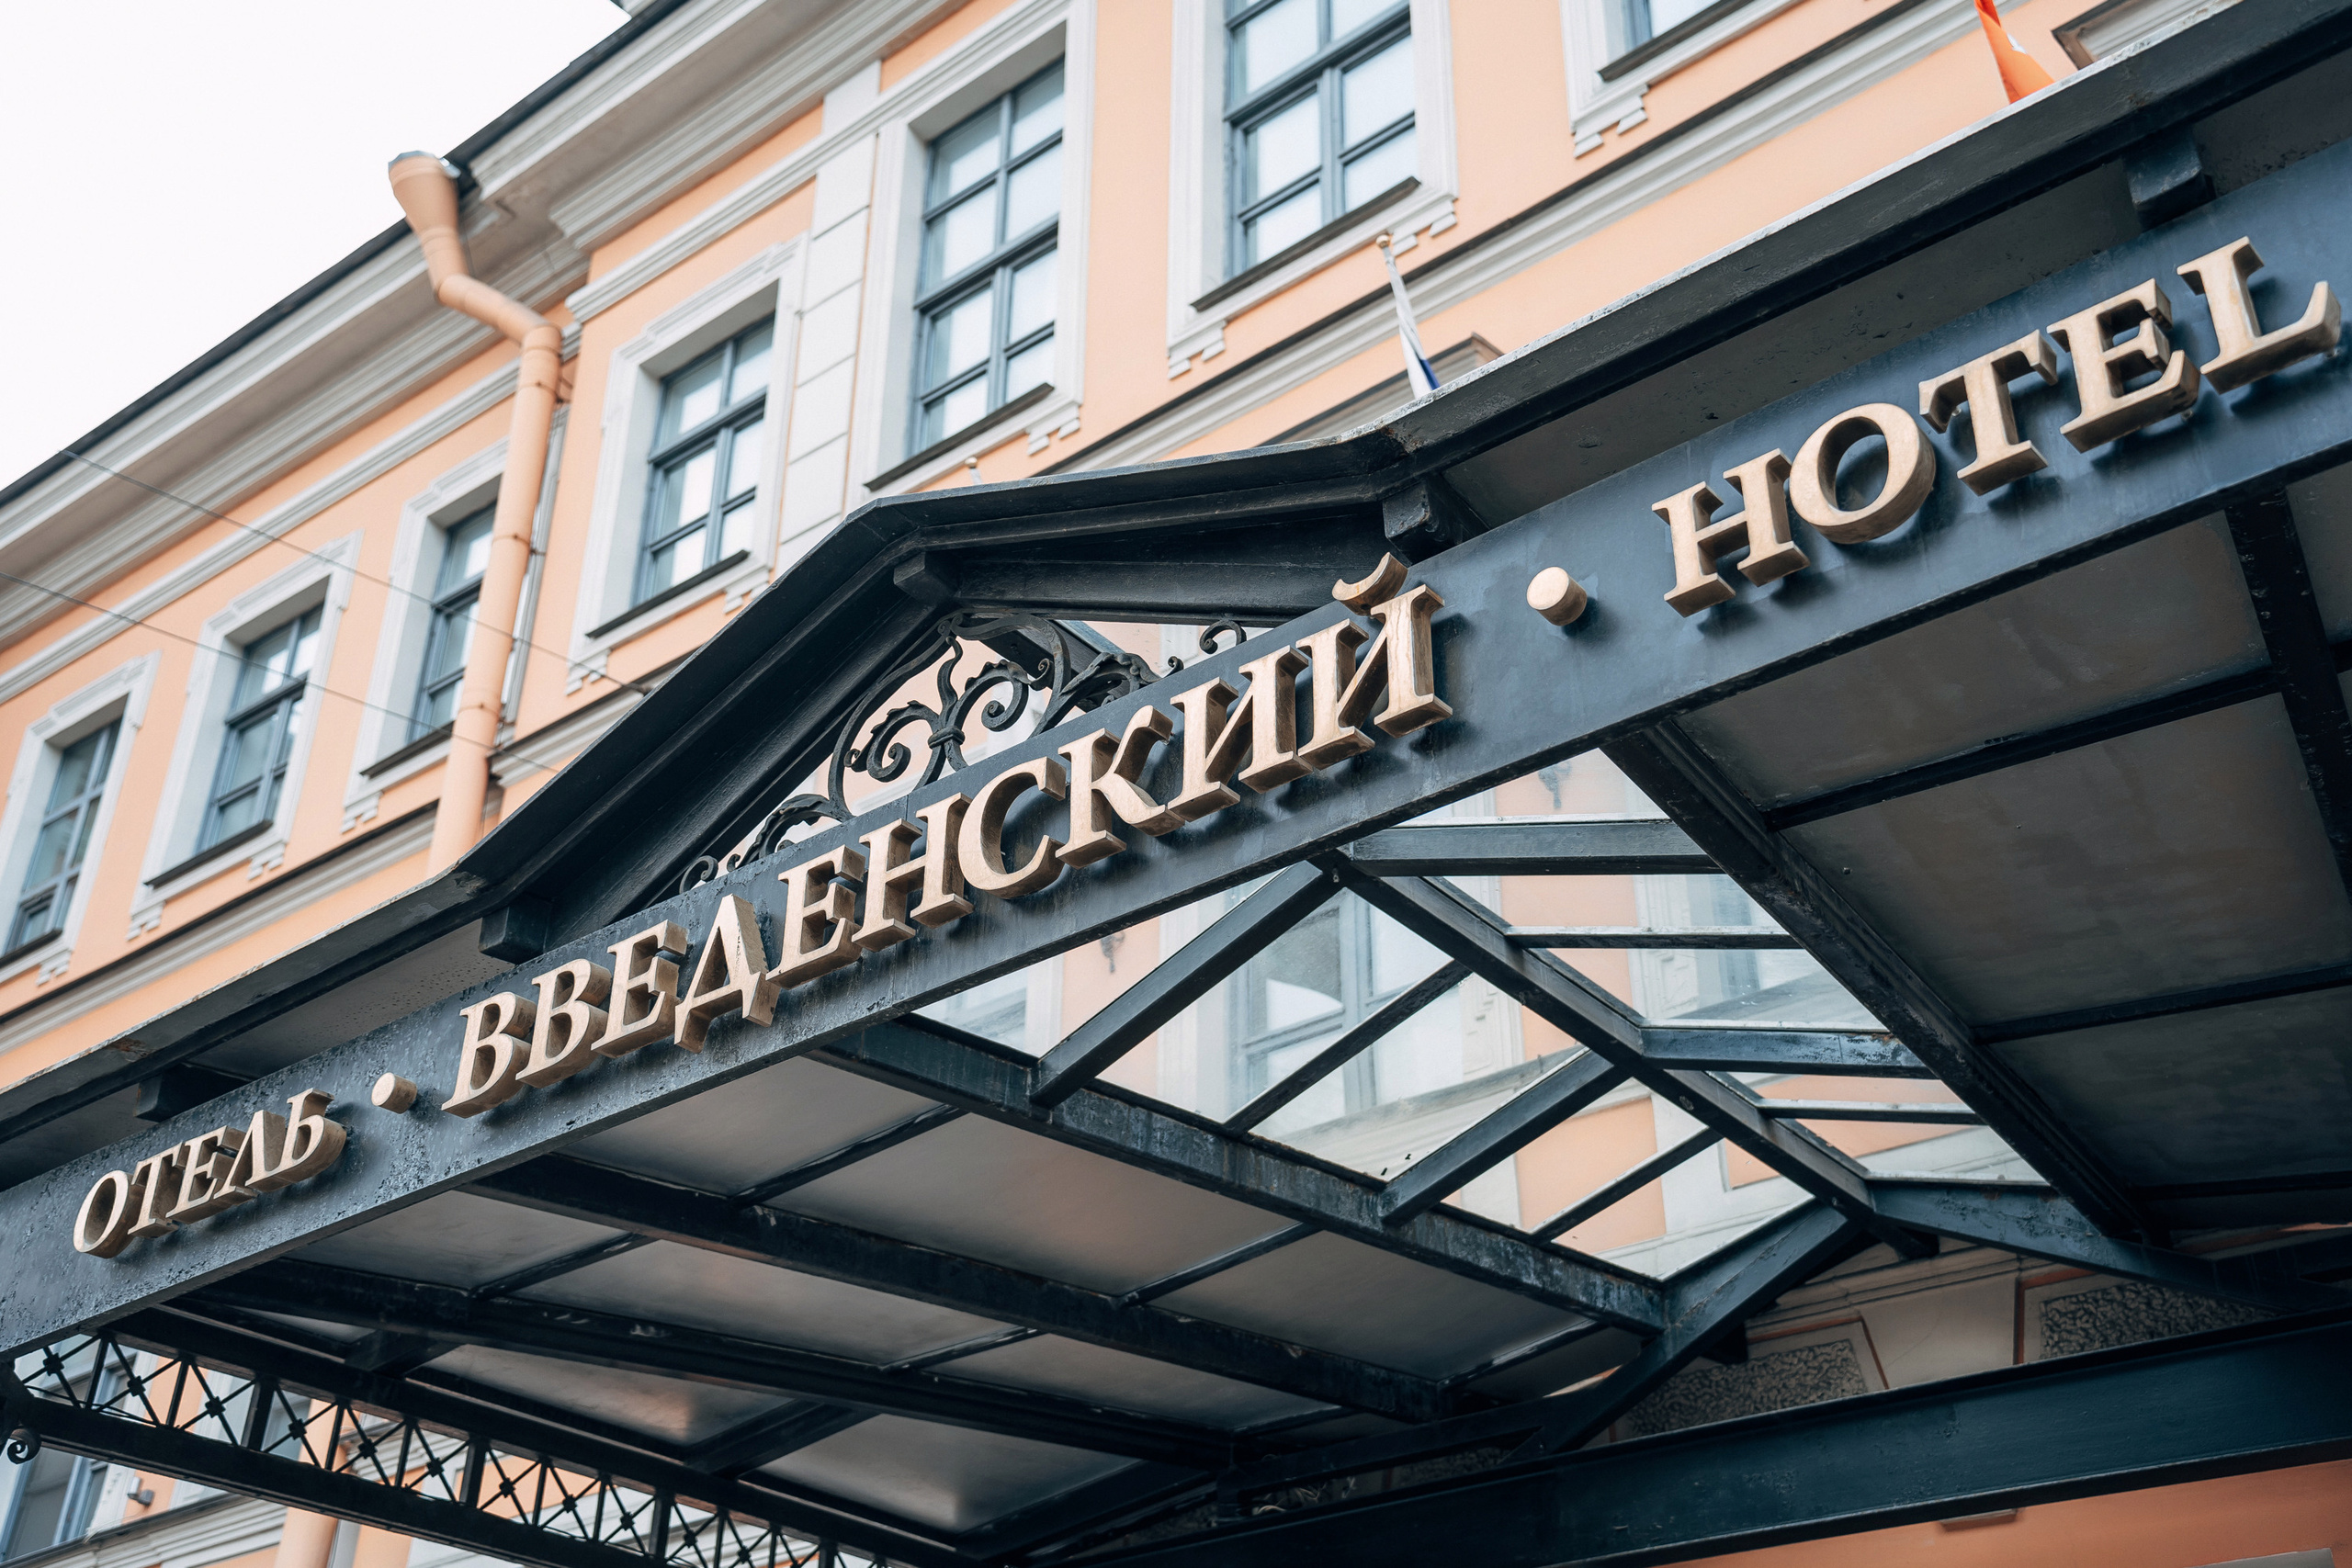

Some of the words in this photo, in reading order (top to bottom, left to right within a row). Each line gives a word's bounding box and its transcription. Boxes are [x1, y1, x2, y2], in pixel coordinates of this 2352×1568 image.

[1651, 236, 2342, 618] HOTEL
[74, 1088, 346, 1258] ОТЕЛЬ
[441, 552, 1453, 1118] ВВЕДЕНСКИЙ
